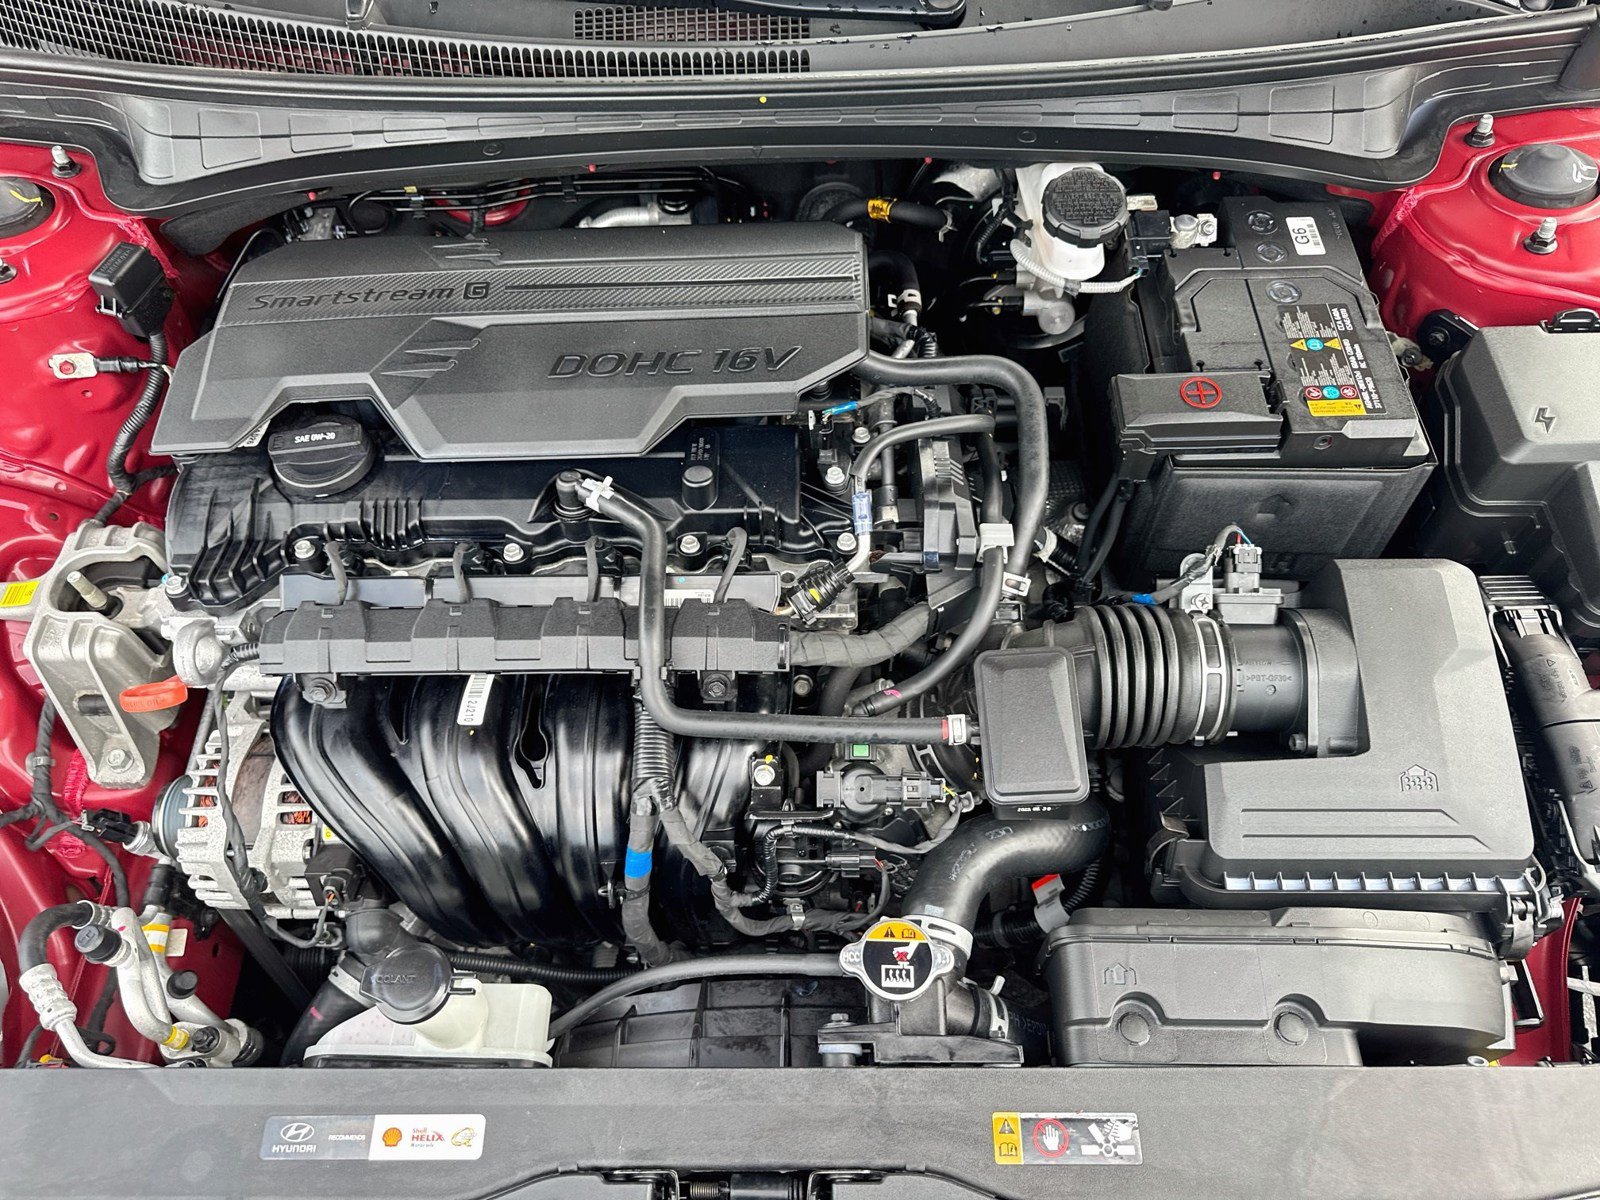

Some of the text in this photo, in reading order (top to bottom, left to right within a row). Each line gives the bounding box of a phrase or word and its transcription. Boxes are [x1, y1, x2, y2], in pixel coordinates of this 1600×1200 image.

[1291, 227, 1310, 245] G6
[248, 287, 454, 310] Smartstream
[548, 345, 802, 379] DOHC 16V
[294, 432, 336, 444] SAE 0W-20
[841, 951, 861, 963] HCC
[411, 1131, 445, 1142] HELIX
[272, 1144, 317, 1153] HYUNDAI
